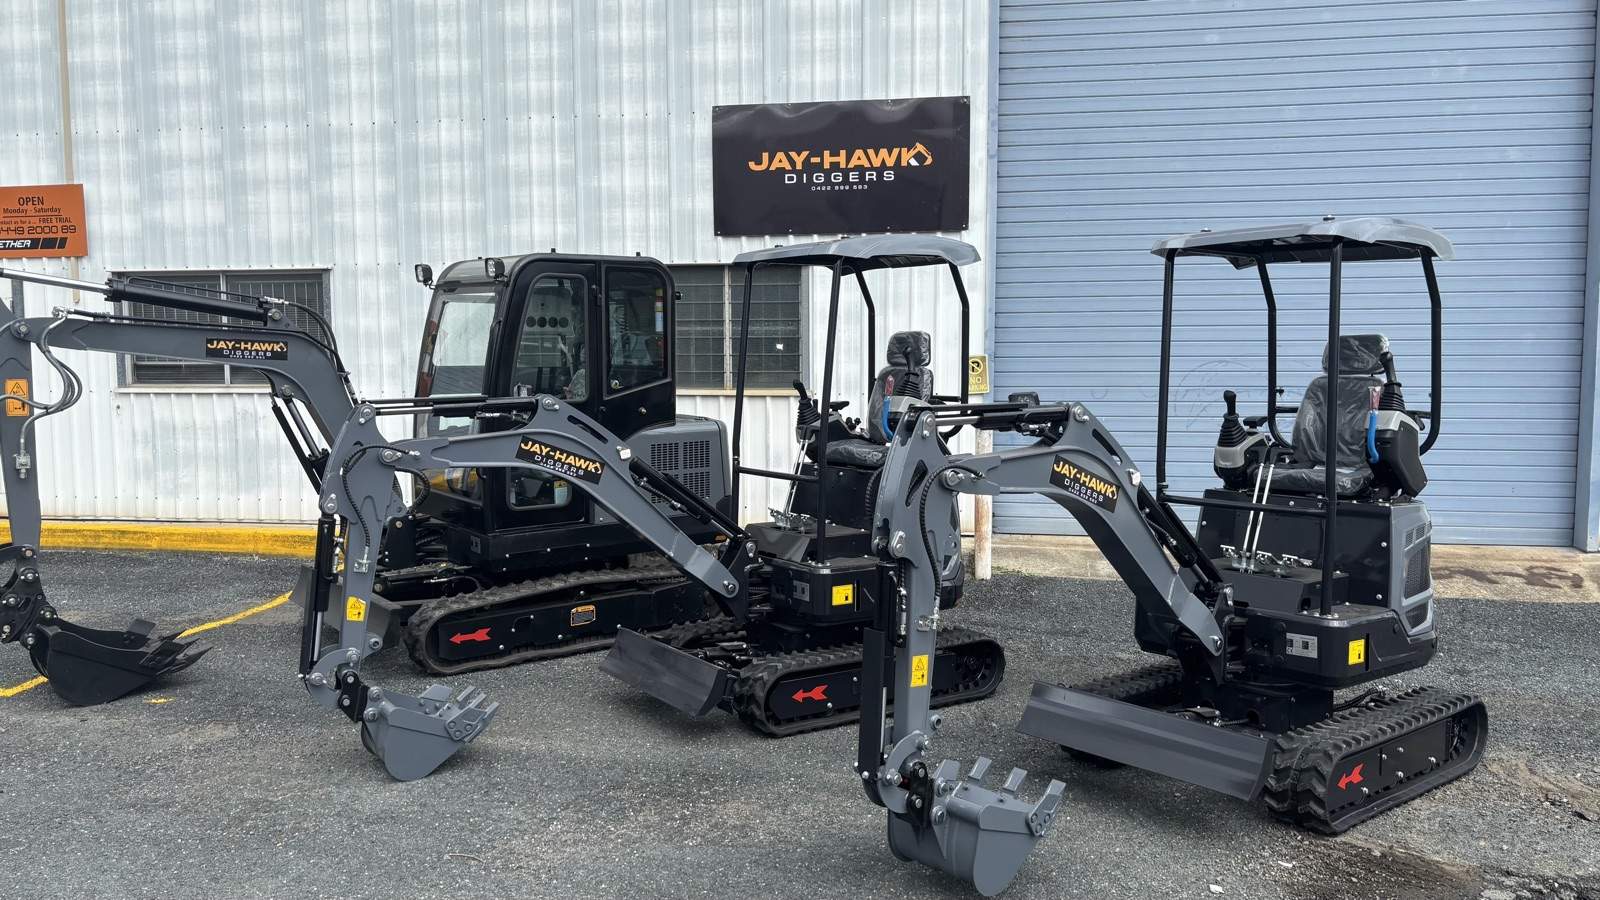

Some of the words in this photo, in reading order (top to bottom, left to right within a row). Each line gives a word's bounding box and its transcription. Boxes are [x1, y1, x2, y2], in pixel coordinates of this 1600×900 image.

[748, 144, 931, 171] JAY-HAWK
[784, 171, 895, 184] DIGGERS
[17, 196, 44, 206] OPEN
[3, 207, 28, 215] Monday
[33, 206, 62, 214] Saturday
[0, 226, 25, 236] 449
[27, 225, 59, 235] 2000
[61, 224, 77, 234] 89
[207, 340, 286, 352] JAY-HAWK
[520, 441, 601, 474] JAY-HAWK
[534, 454, 584, 476] DIGGERS
[1053, 461, 1117, 499] JAY-HAWK
[1064, 478, 1104, 502] DIGGERS
